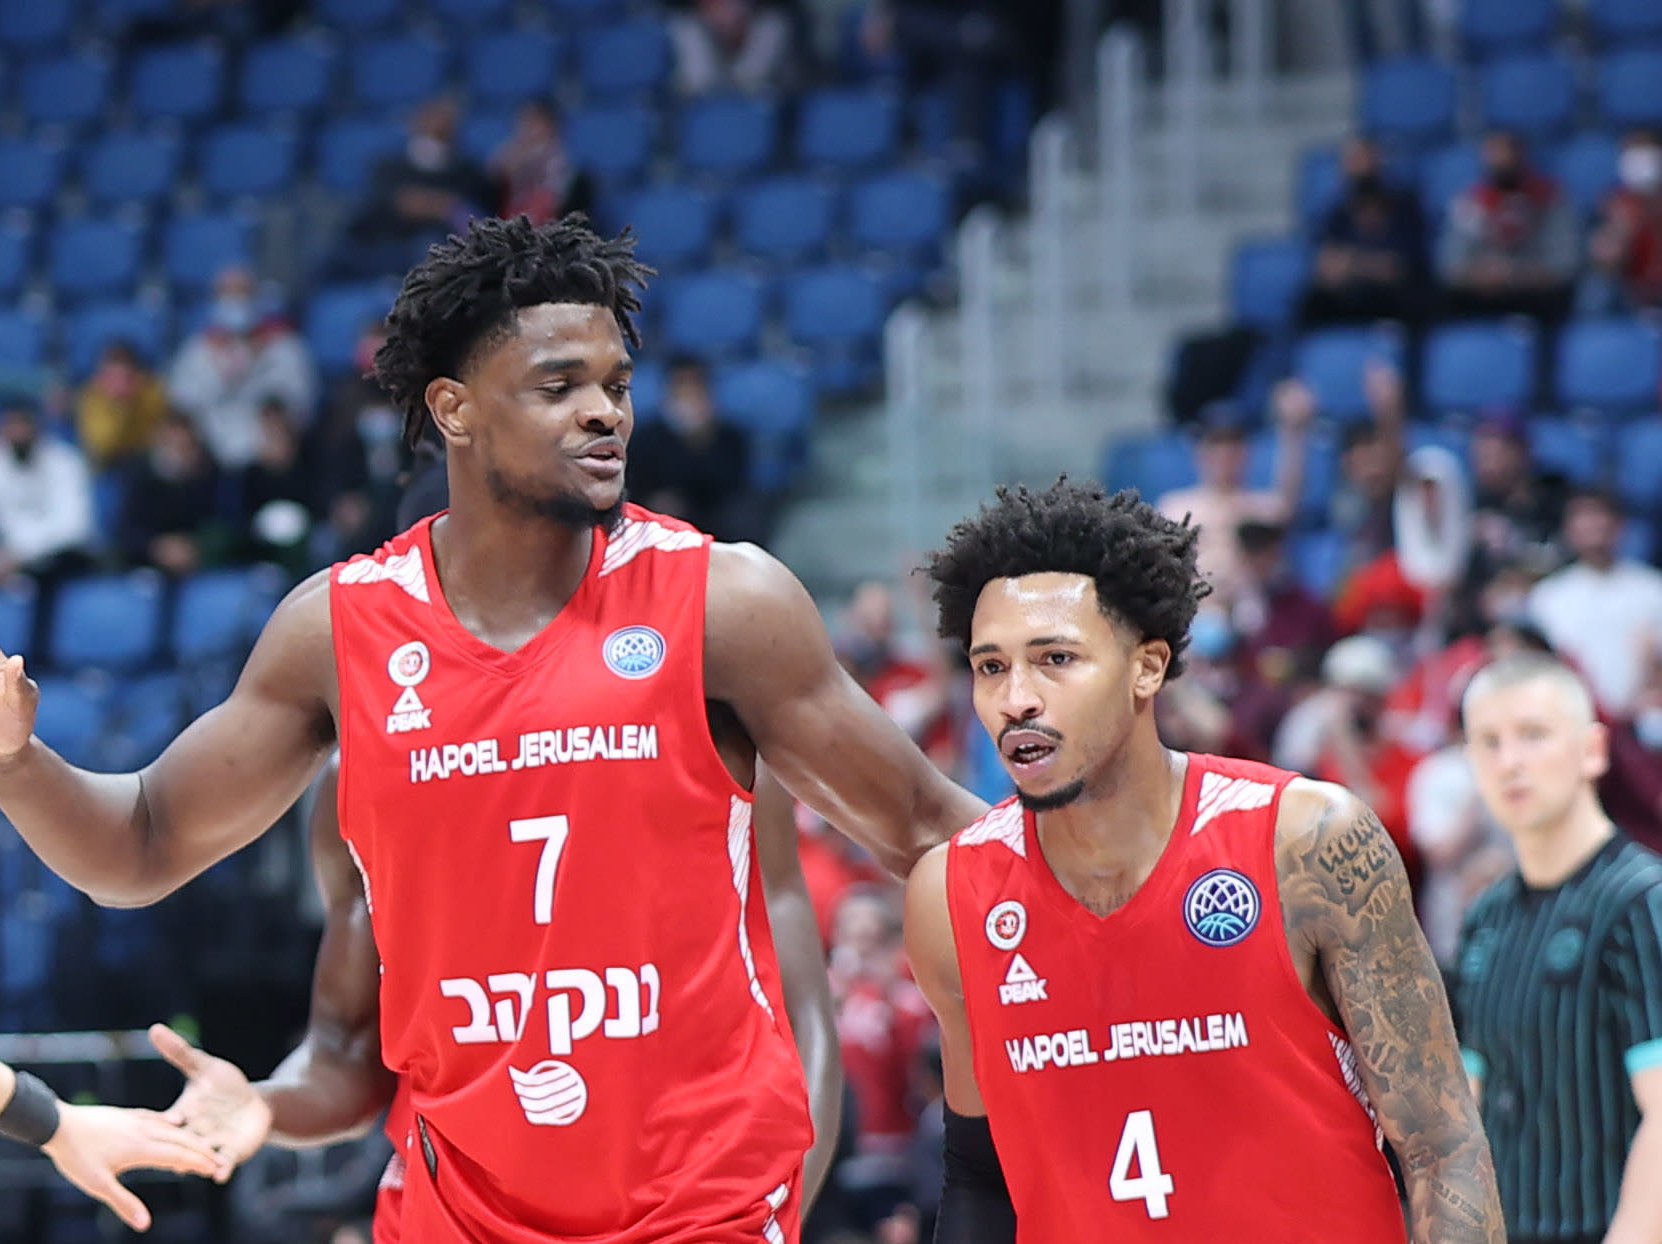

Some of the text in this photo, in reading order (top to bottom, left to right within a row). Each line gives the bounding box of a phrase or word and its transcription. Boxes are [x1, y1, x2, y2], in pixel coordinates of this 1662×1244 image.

[385, 708, 433, 734] PEAK
[409, 724, 659, 784] HAPOEL JERUSALEM
[508, 814, 570, 925] 7
[998, 978, 1050, 1006] PEAK
[1005, 1012, 1249, 1073] HAPOEL JERUSALEM
[1107, 1109, 1175, 1220] 4
